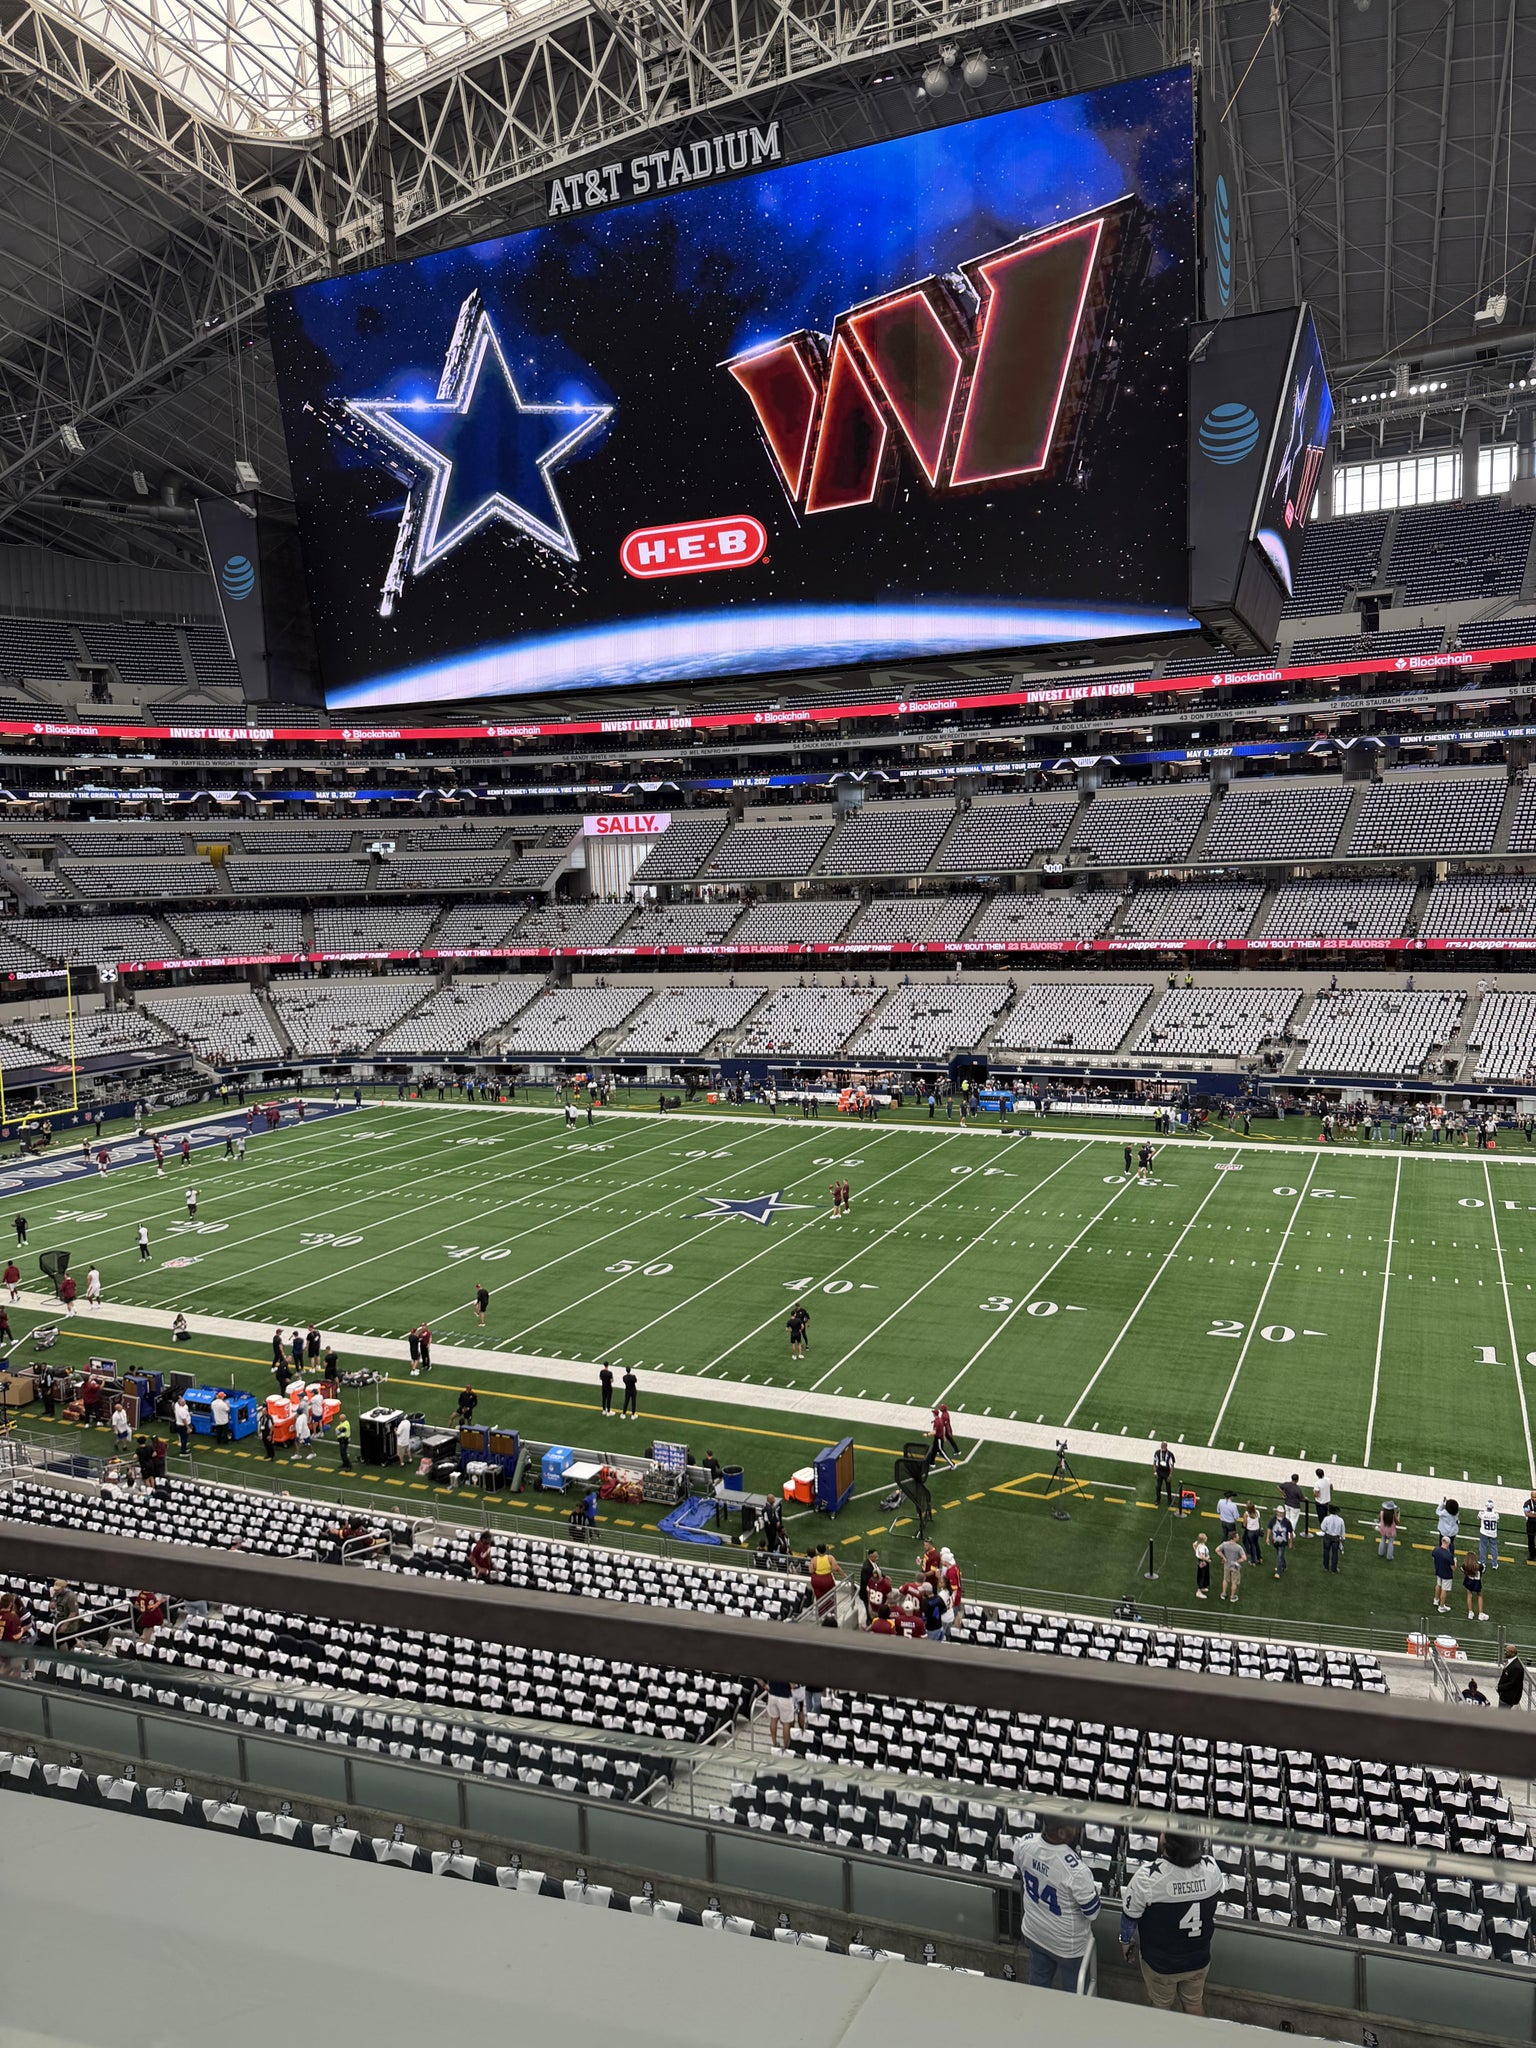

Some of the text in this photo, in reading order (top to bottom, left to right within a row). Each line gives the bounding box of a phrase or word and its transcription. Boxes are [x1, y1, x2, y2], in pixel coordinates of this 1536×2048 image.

[549, 121, 782, 217] AT&T STADIUM
[1410, 653, 1473, 669] Blockchain
[1225, 670, 1282, 684] Blockchain
[1027, 683, 1134, 702] INVEST LIKE AN ICON
[909, 700, 957, 711] Blockchain
[1365, 698, 1401, 706] STAUBACH
[764, 711, 810, 721] Blockchain
[46, 724, 98, 735] Blockchain
[497, 726, 541, 736] Blockchain
[601, 717, 692, 732] INVEST LIKE AN ICON
[170, 727, 274, 739] INVEST LIKE AN ICON
[352, 729, 401, 739] Blockchain
[1186, 751, 1203, 759] MAY
[1214, 749, 1234, 757] 2027
[596, 815, 659, 834] SALLY.
[1296, 940, 1321, 948] THEM
[101, 968, 117, 982] 25
[300, 1233, 364, 1248] 30
[443, 1245, 512, 1261] 40
[605, 1259, 674, 1276] 50
[783, 1276, 853, 1294] 40
[979, 1296, 1059, 1317] 30
[1206, 1319, 1297, 1343] 20
[1032, 1858, 1050, 1878] WARE
[1023, 1870, 1062, 1916] 94
[1172, 1879, 1207, 1896] PRESCOTT
[1179, 1902, 1203, 1938] 4
